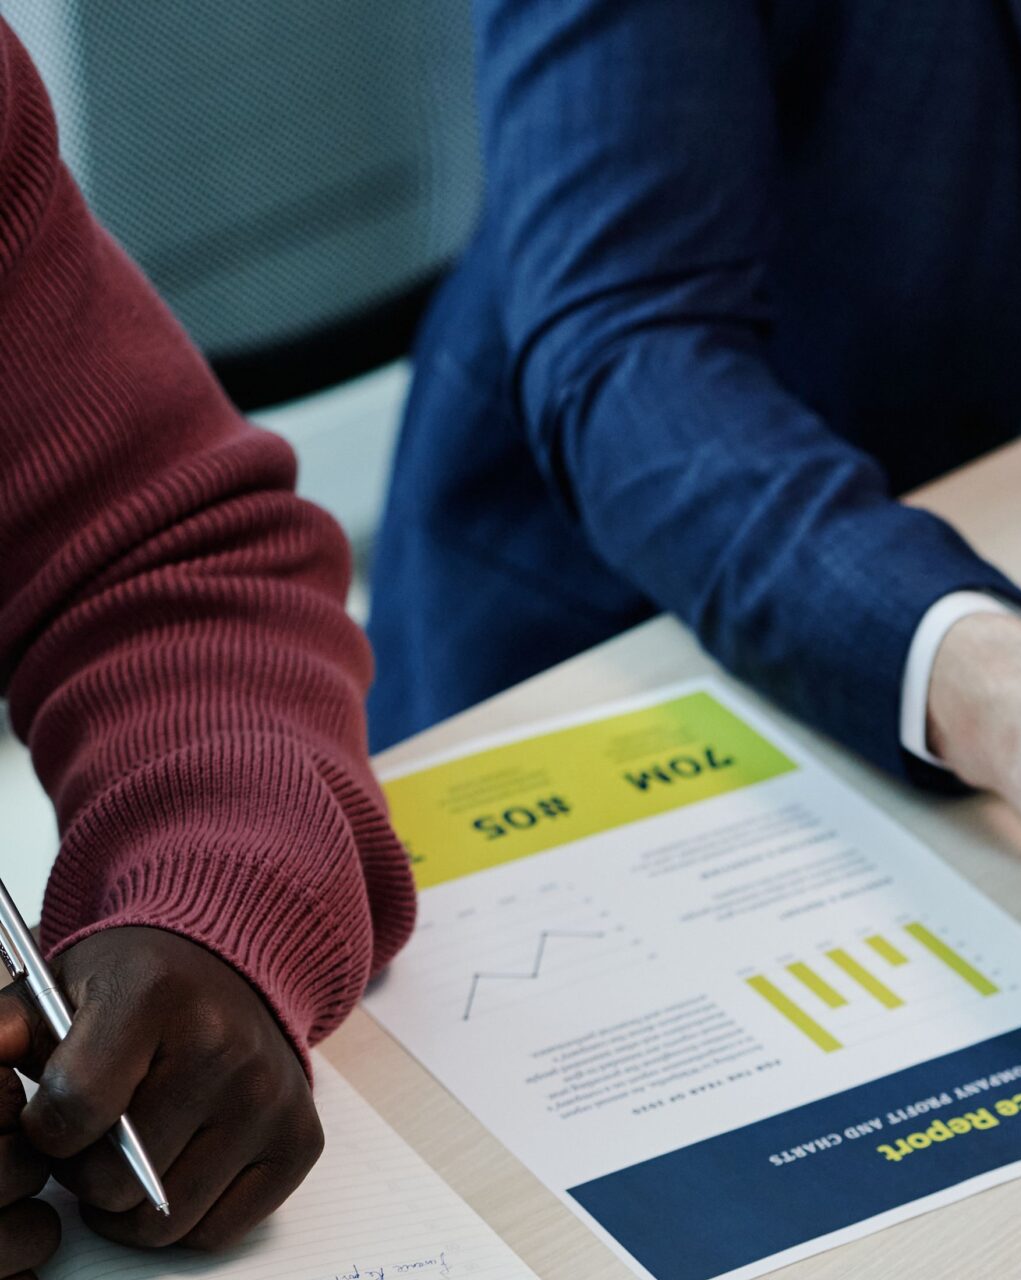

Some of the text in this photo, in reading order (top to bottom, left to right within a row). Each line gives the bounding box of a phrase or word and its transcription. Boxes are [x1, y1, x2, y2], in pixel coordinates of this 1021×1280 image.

[886, 1093, 952, 1125] PROFIT
[843, 1117, 883, 1140] AND
[876, 1106, 999, 1162] Report
[768, 1132, 843, 1167] CHARTS
